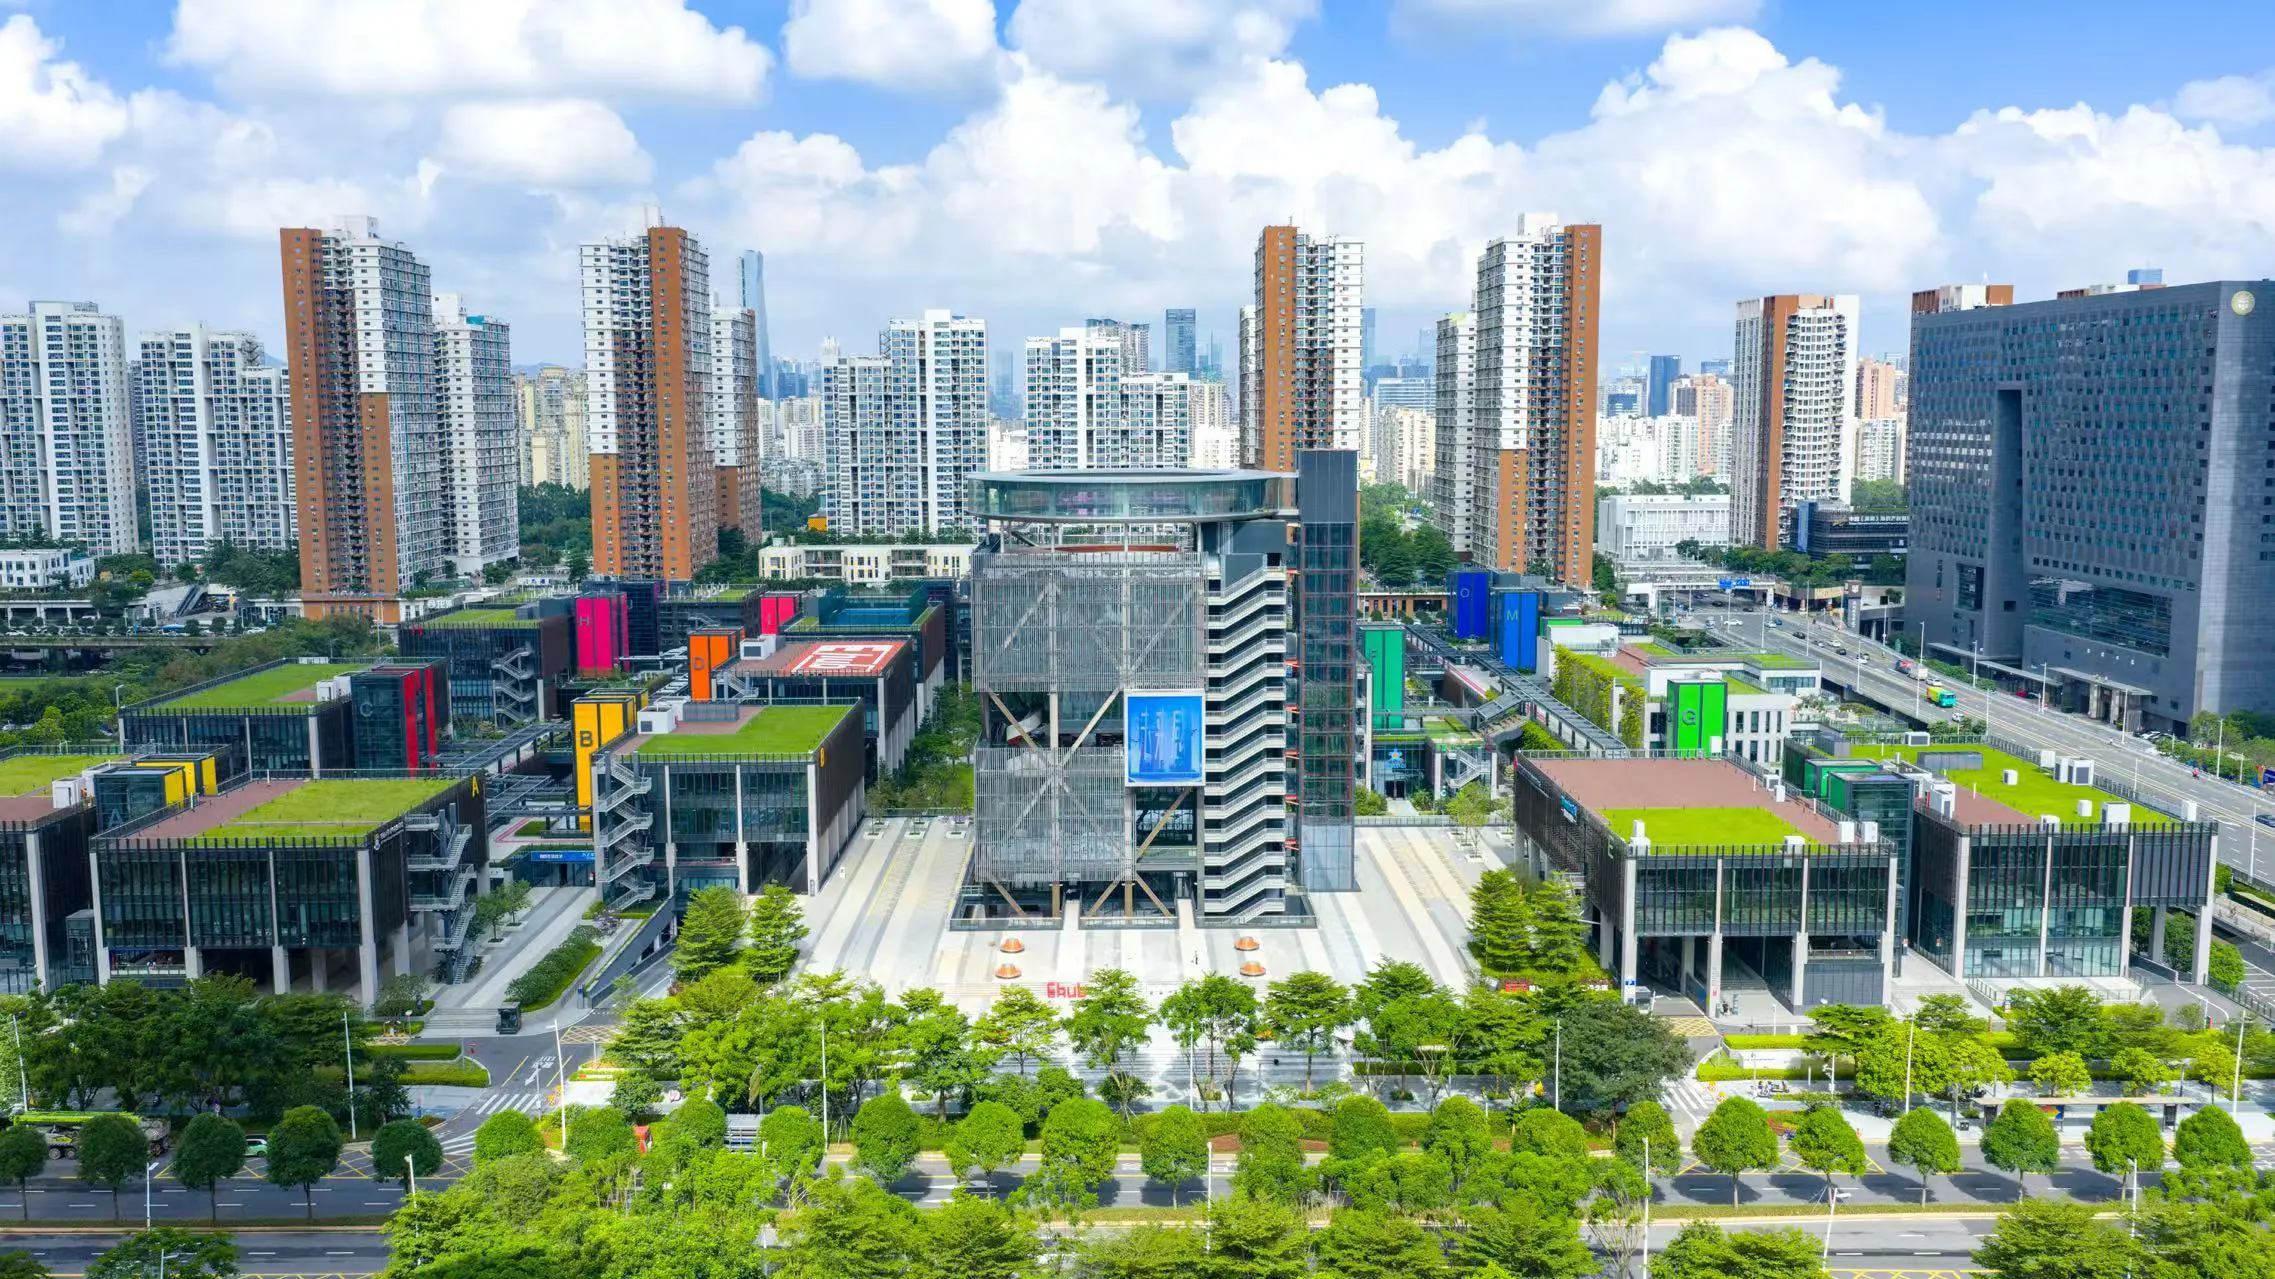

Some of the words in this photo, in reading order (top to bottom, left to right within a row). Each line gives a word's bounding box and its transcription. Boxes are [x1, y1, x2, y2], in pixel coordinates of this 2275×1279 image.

[580, 615, 590, 627] H
[1506, 608, 1518, 621] M
[693, 655, 705, 671] D
[360, 701, 373, 717] C
[1682, 708, 1696, 726] G
[580, 730, 593, 748] B
[472, 775, 480, 798] A
